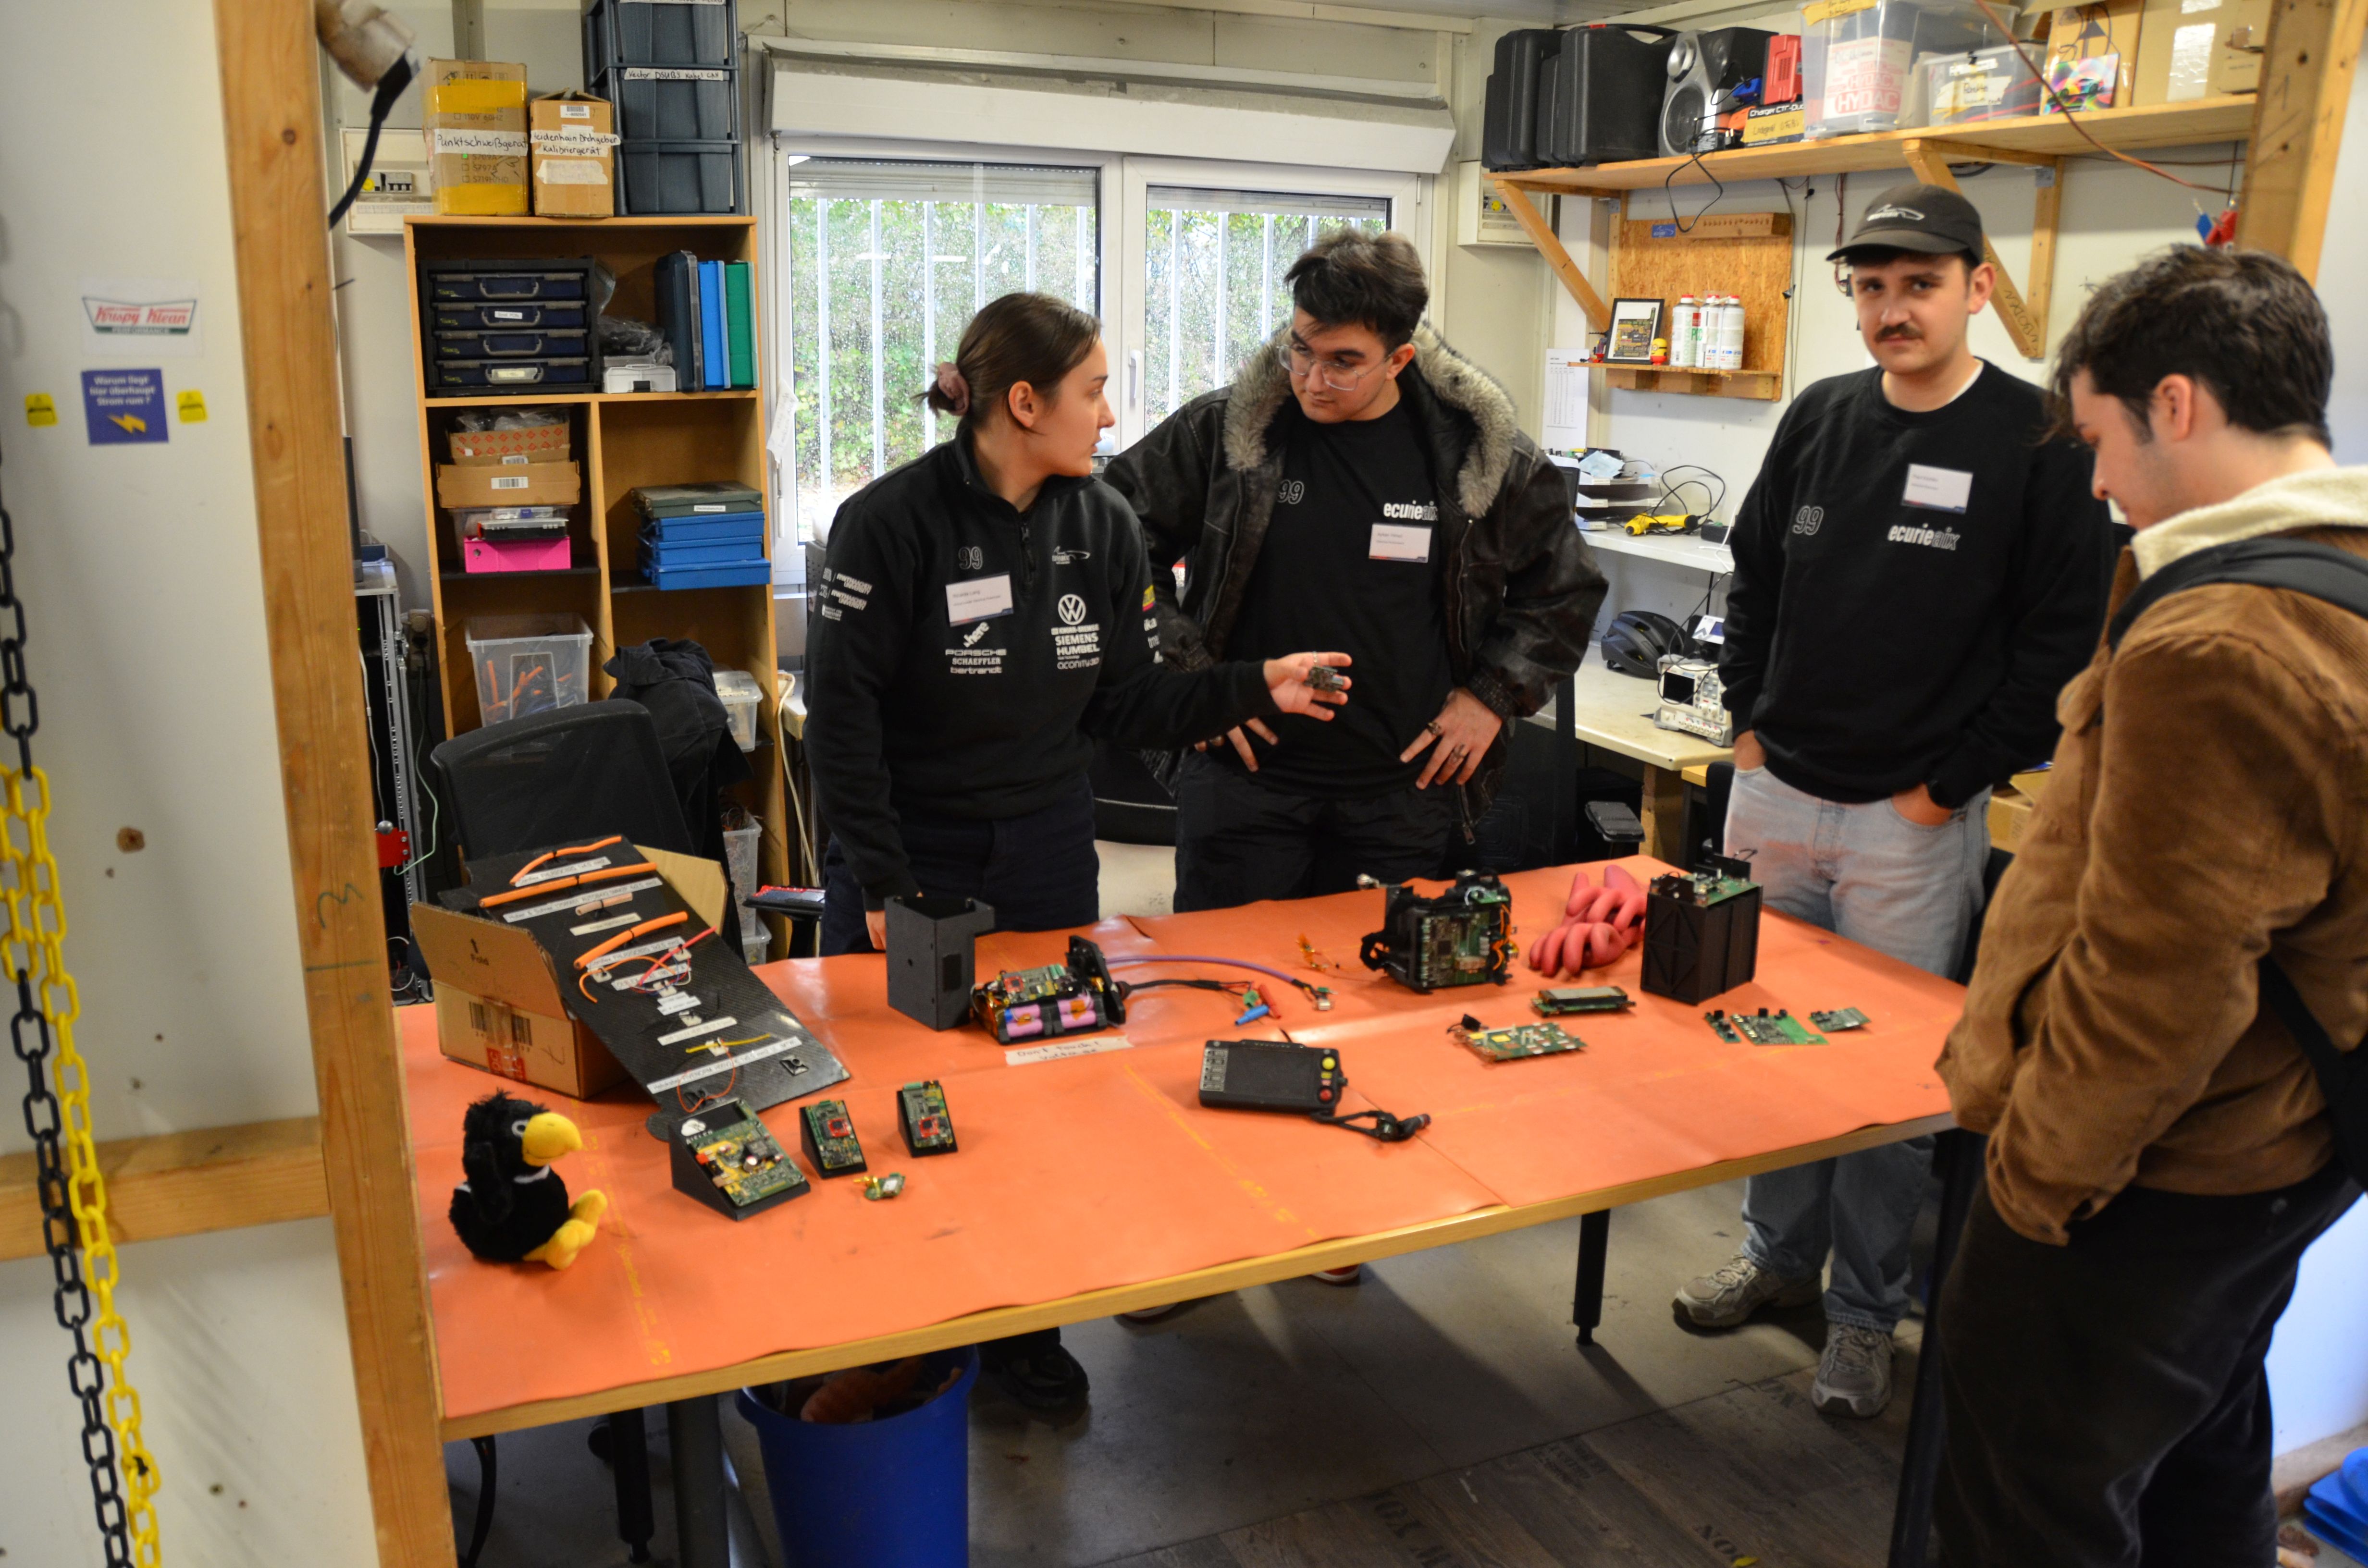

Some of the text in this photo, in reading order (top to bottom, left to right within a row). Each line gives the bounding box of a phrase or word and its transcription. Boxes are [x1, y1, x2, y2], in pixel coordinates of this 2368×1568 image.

[1849, 74, 1893, 88] HYDAC
[1838, 93, 1900, 112] HYDAC
[1750, 108, 1775, 117] Charger
[437, 135, 528, 151] Punktschweißgerät
[542, 145, 602, 156] Kalibriergerät
[95, 305, 191, 326] Krispy Klean
[94, 375, 149, 385] Warum liegt
[89, 385, 156, 395] hier überhaupt
[97, 397, 123, 406] Strom
[1278, 479, 1305, 505] 99
[1792, 505, 1825, 536] 99
[1887, 523, 1961, 551] ecurieaix
[958, 546, 984, 570] 99
[1055, 632, 1099, 646] SIEMENS
[1057, 643, 1101, 656] HUMBEL
[952, 657, 1001, 665] SCHAEFFLER
